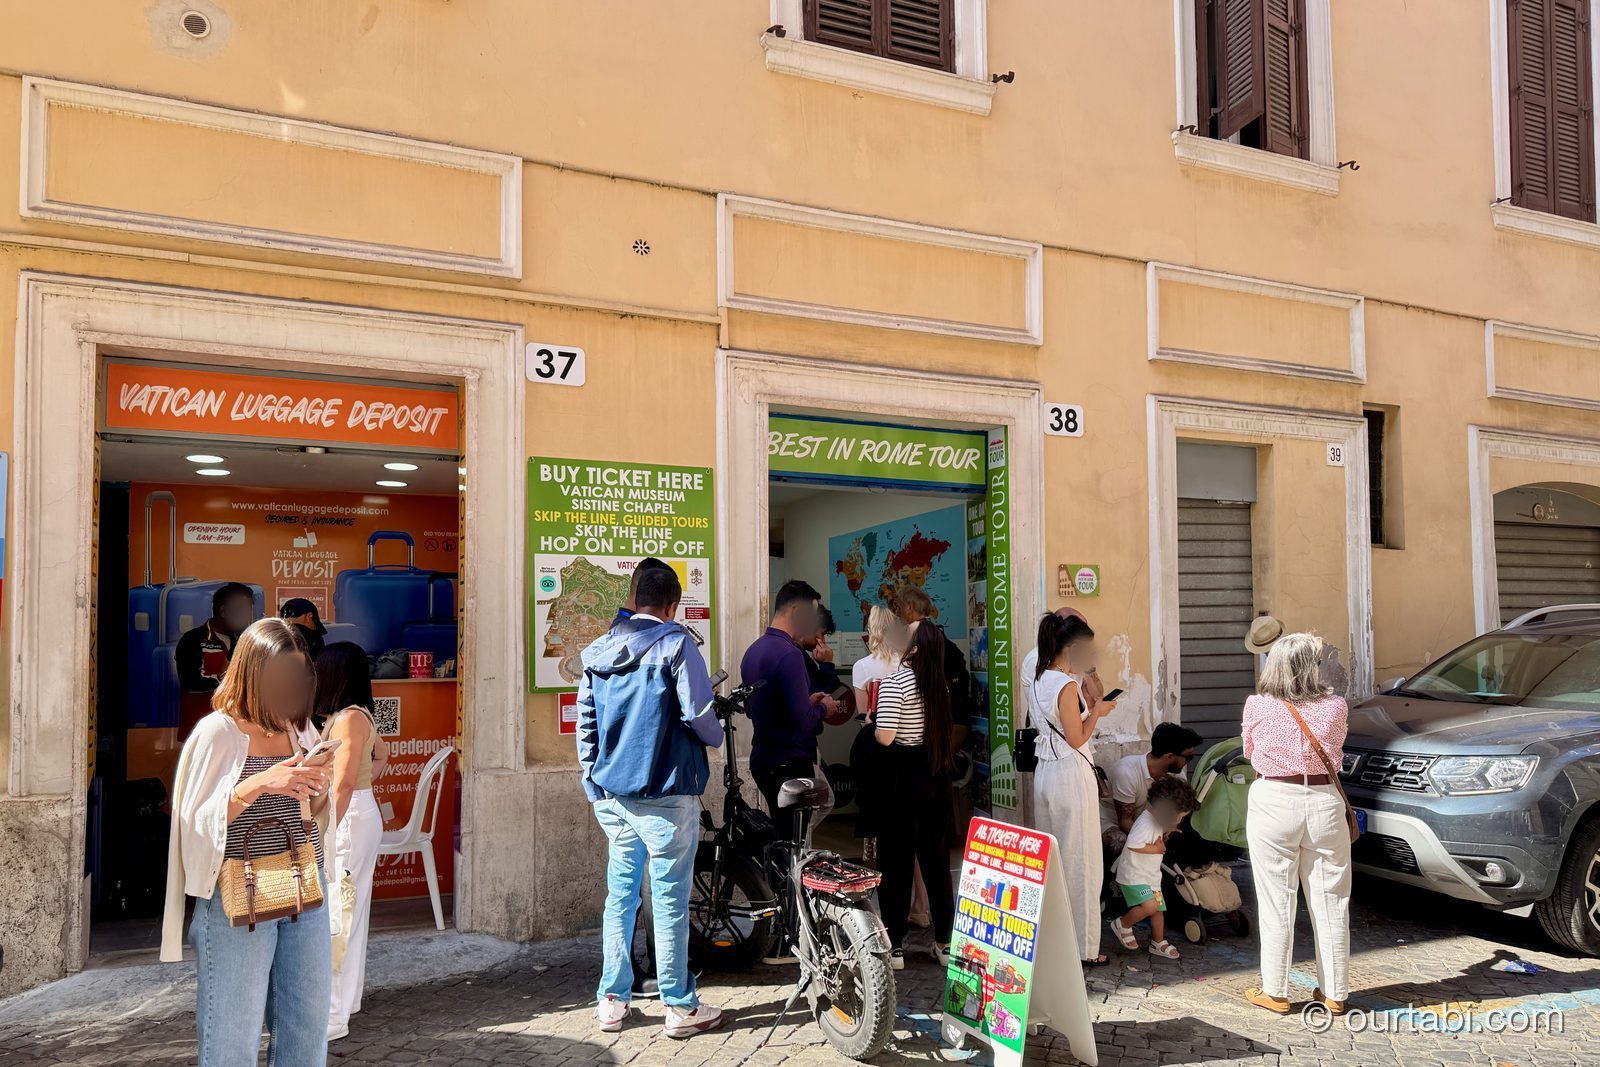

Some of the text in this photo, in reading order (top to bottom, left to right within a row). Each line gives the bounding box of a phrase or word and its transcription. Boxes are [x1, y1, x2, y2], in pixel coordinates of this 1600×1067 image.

[535, 349, 577, 380] 37
[120, 383, 448, 436] VATICAN LUGGAGE DEPOSIT
[1050, 407, 1078, 432] 38
[768, 431, 980, 470] BEST IN ROME TOUR
[1330, 447, 1341, 461] 39
[540, 464, 704, 490] BUY TICKET HERE
[560, 485, 686, 502] VATICAN MUSEUM
[231, 502, 389, 516] www.vaticanluggagedeposit.com
[572, 498, 676, 515] SISTINE CHAPEL
[188, 525, 218, 533] OPENING
[264, 515, 299, 524] SECURED
[311, 516, 355, 526] INSURANCE
[534, 510, 708, 529] SKIP THE LINE, GUIDED TOURS
[575, 525, 672, 540] SKIP THE LINE
[272, 550, 340, 559] VATICAN LUGGAGE
[540, 536, 580, 552] HOP
[584, 538, 614, 553] ON
[632, 539, 668, 554] HOP
[673, 541, 704, 556] OFF
[272, 559, 339, 578] DEPOSIT
[992, 470, 1010, 739] BEST IN ROME TOUR
[987, 827, 1020, 849] TICKETS
[1019, 835, 1042, 854] HERE
[959, 897, 1035, 940] OPEN BUS TOURS
[956, 912, 973, 934] HOP
[974, 921, 987, 941] ON
[992, 927, 1012, 950] HOP
[1013, 936, 1033, 959] OFF
